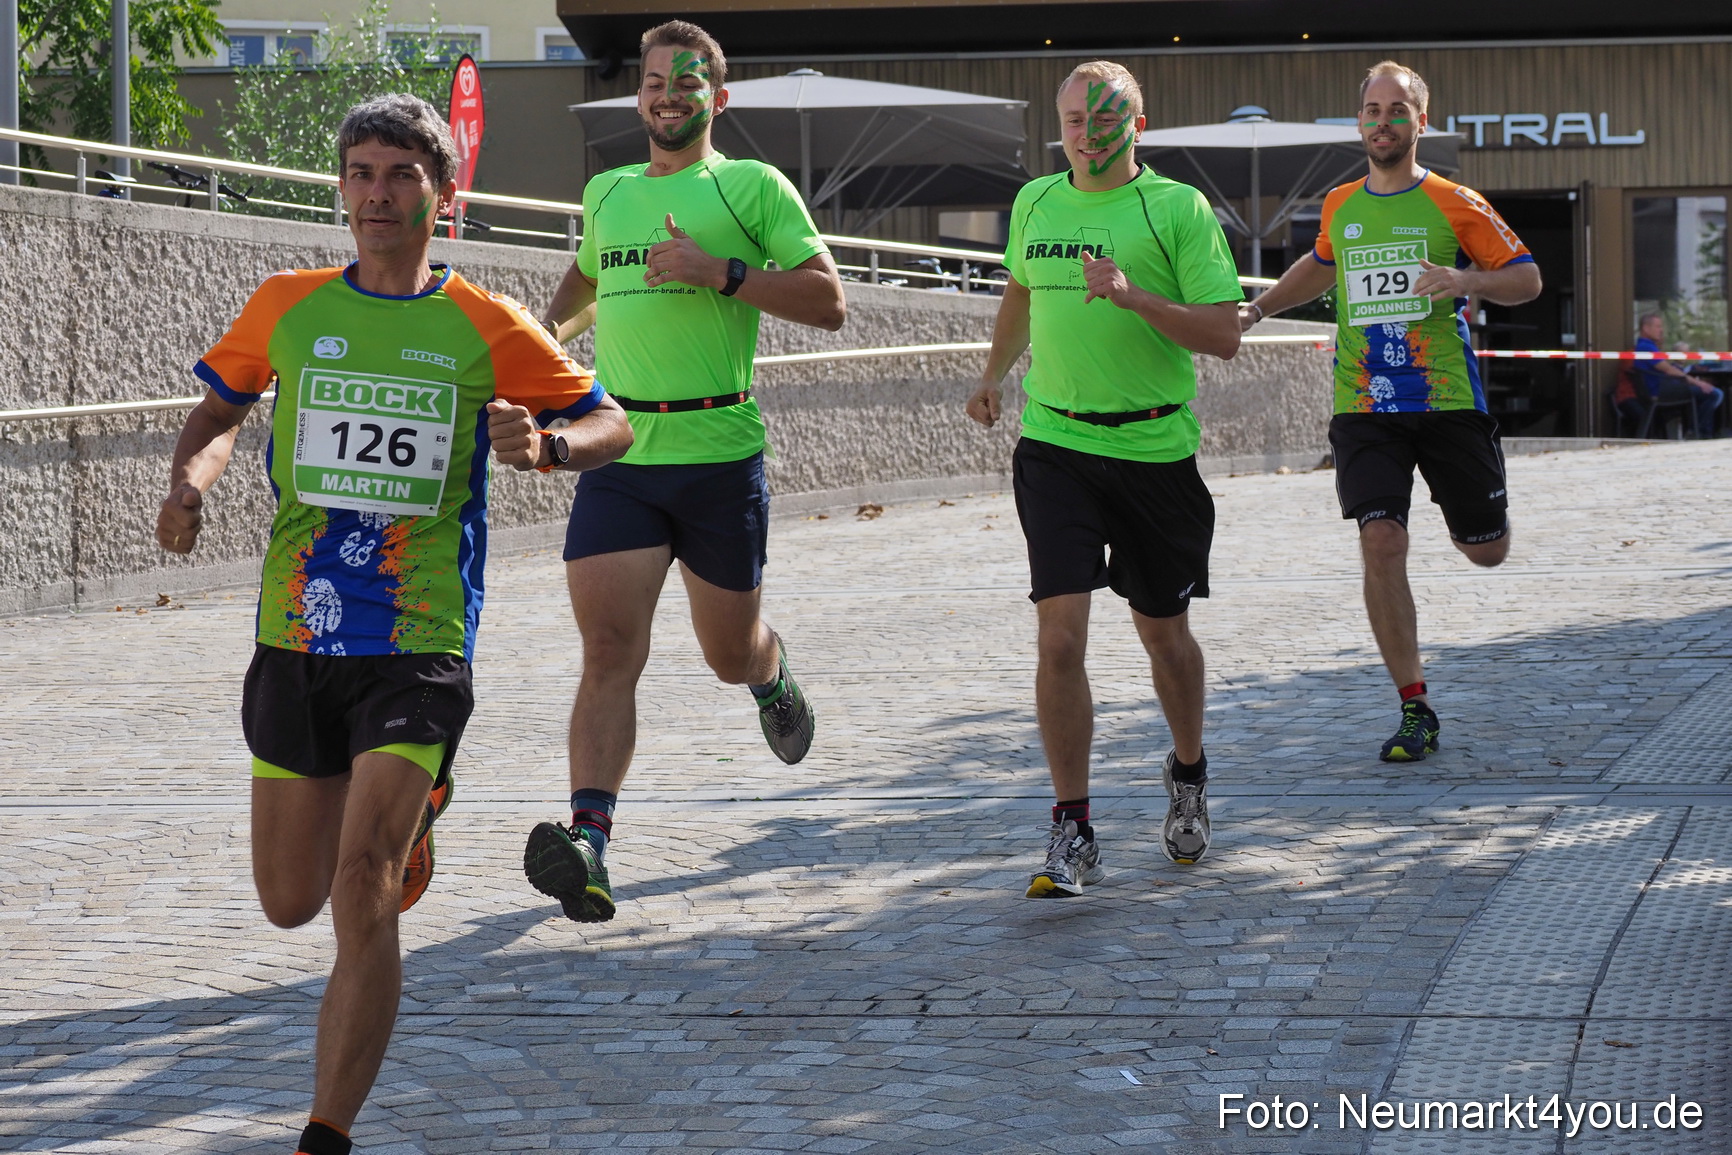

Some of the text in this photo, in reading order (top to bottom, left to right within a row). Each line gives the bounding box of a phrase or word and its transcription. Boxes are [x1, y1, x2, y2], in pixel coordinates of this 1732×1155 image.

[1392, 226, 1428, 236] BOCK
[1348, 244, 1421, 269] BOCK
[1361, 270, 1409, 297] 129
[1354, 300, 1422, 316] JOHANNES
[401, 348, 457, 370] BOCK
[311, 375, 442, 418] BOCK
[330, 421, 418, 467] 126
[435, 435, 447, 443] E6
[321, 473, 411, 499] MARTIN
